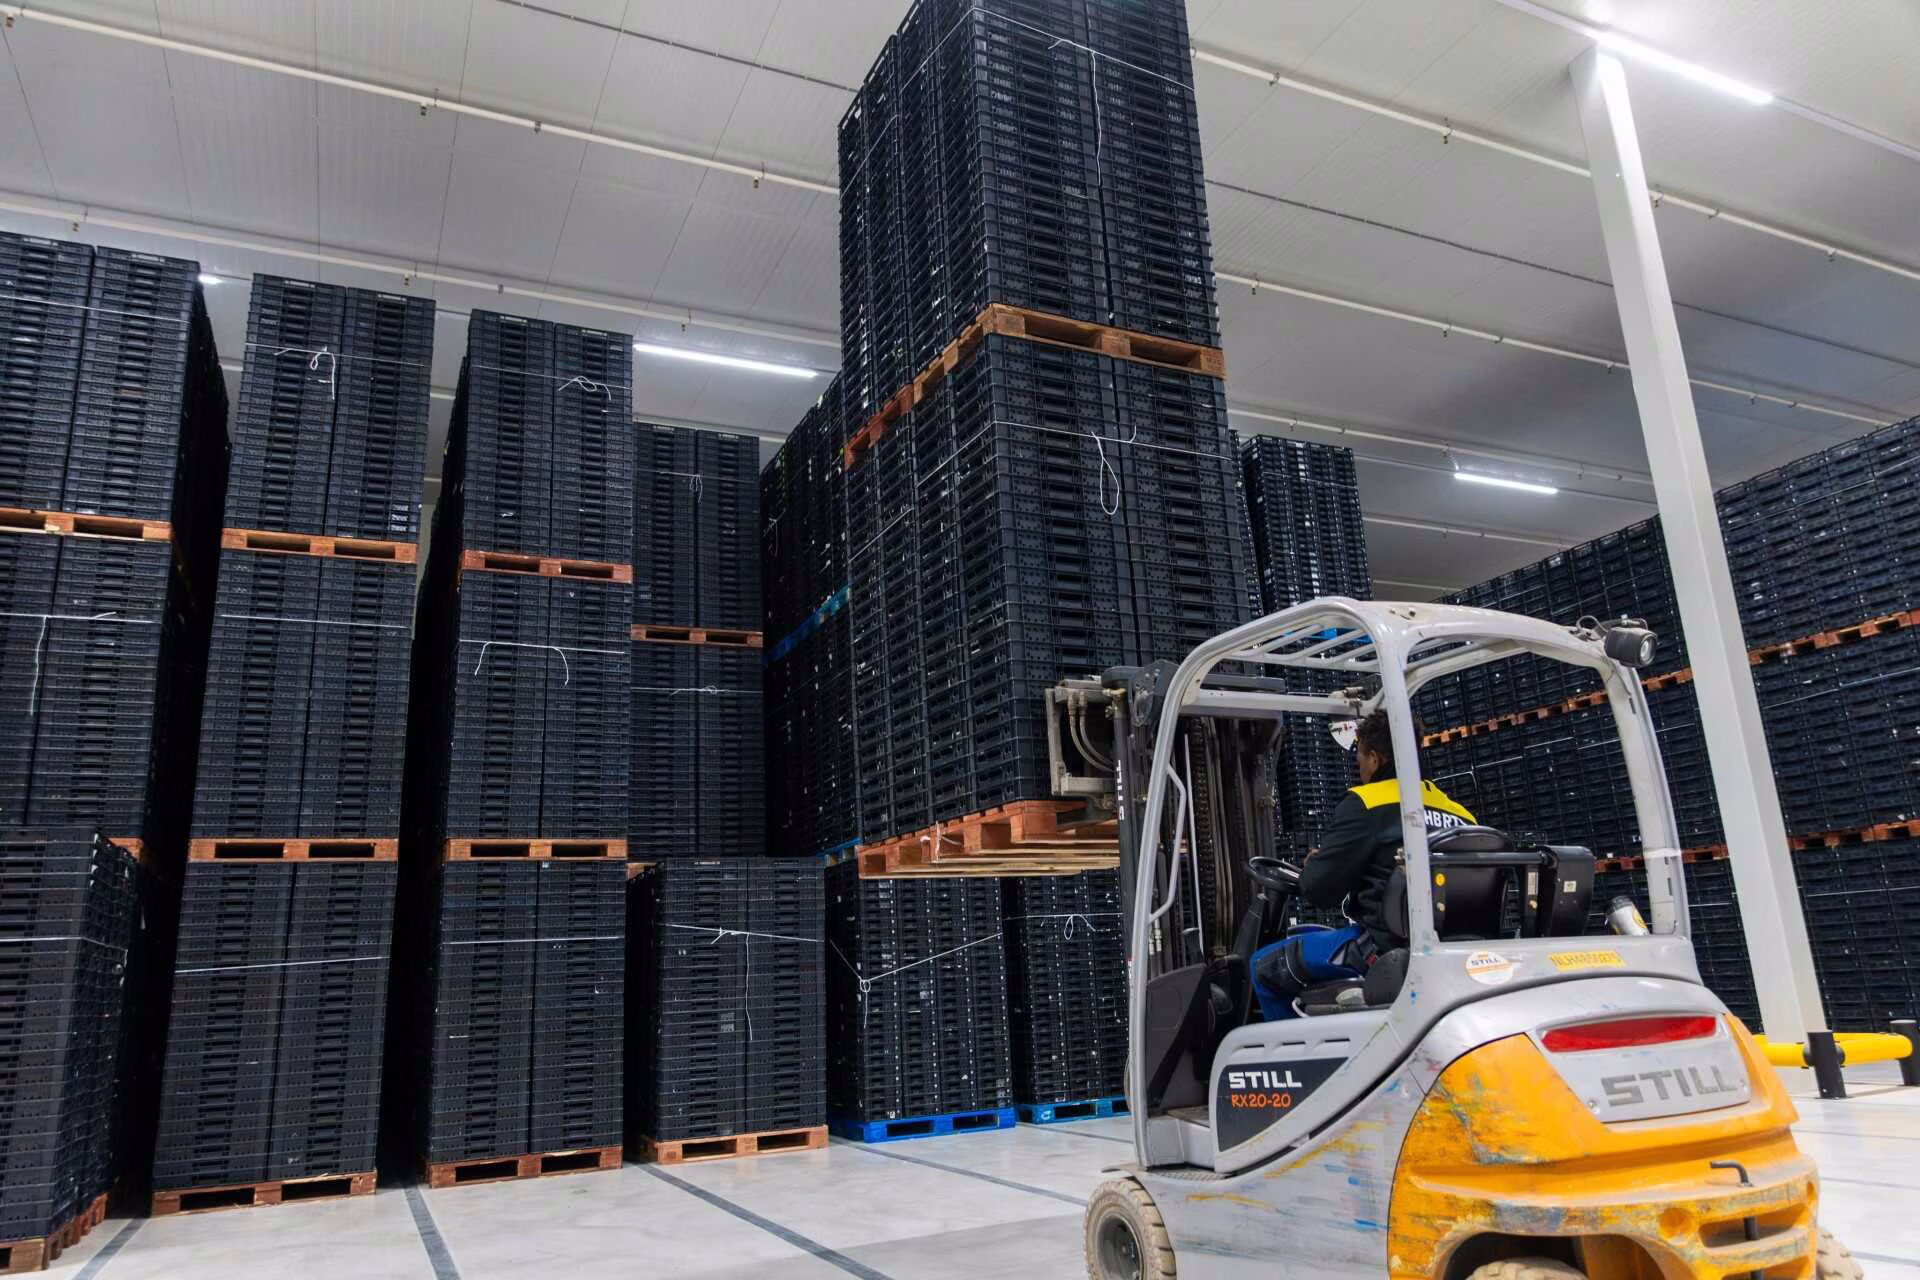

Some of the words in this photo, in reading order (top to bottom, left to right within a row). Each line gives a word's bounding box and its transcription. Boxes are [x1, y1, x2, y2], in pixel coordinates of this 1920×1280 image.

[1228, 1070, 1303, 1089] STILL
[1601, 1065, 1738, 1107] STILL
[1231, 1093, 1292, 1109] RX20-20
